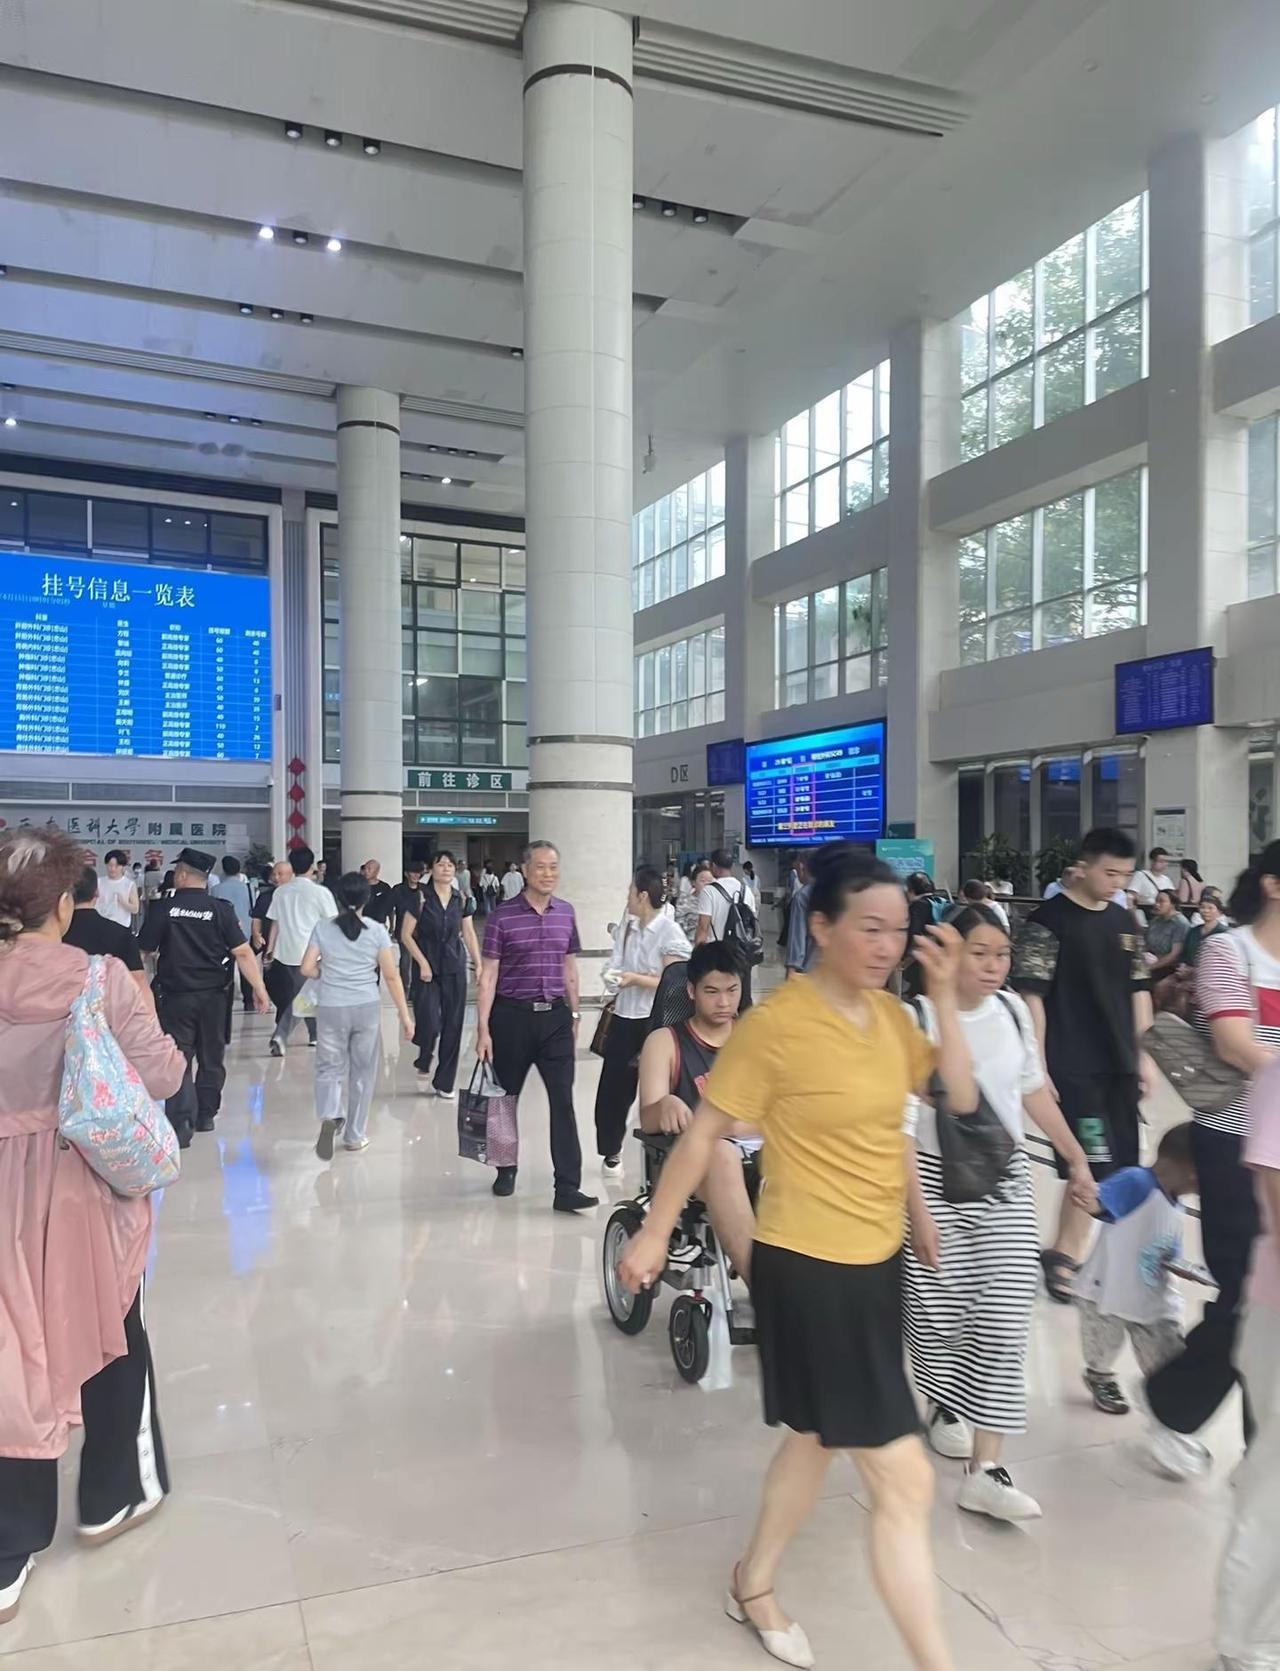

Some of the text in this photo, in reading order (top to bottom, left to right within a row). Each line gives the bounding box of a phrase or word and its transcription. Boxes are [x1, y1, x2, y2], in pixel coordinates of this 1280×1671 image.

[42, 573, 195, 608] 挂号信息一览表
[417, 771, 504, 789] 前往诊区
[671, 764, 689, 783] D区
